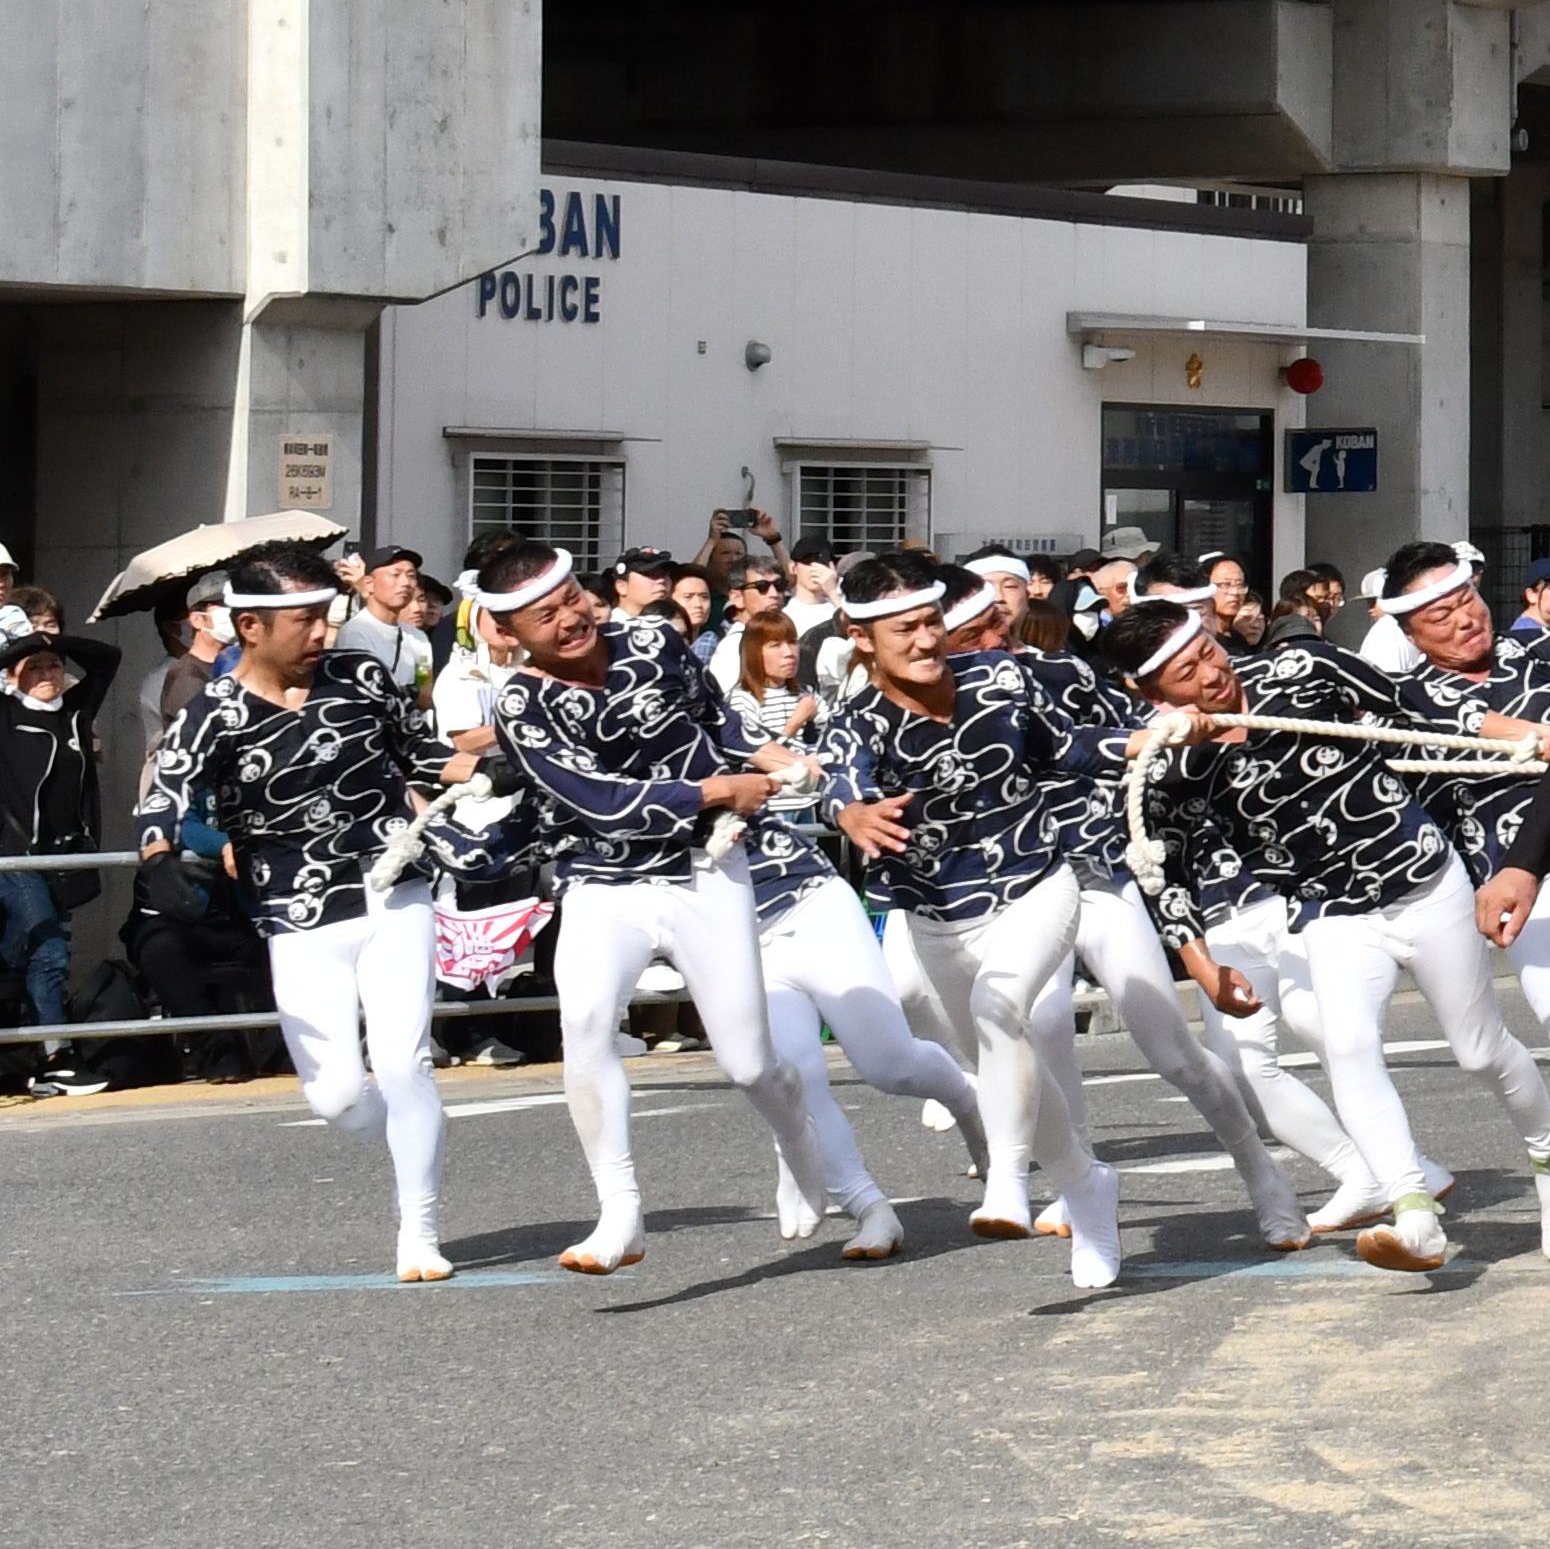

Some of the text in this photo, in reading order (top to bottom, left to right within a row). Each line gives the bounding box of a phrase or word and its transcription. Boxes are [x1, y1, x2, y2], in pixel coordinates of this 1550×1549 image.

[539, 189, 621, 260] BAN
[476, 271, 601, 324] POLICE
[1335, 434, 1375, 449] KOBAN
